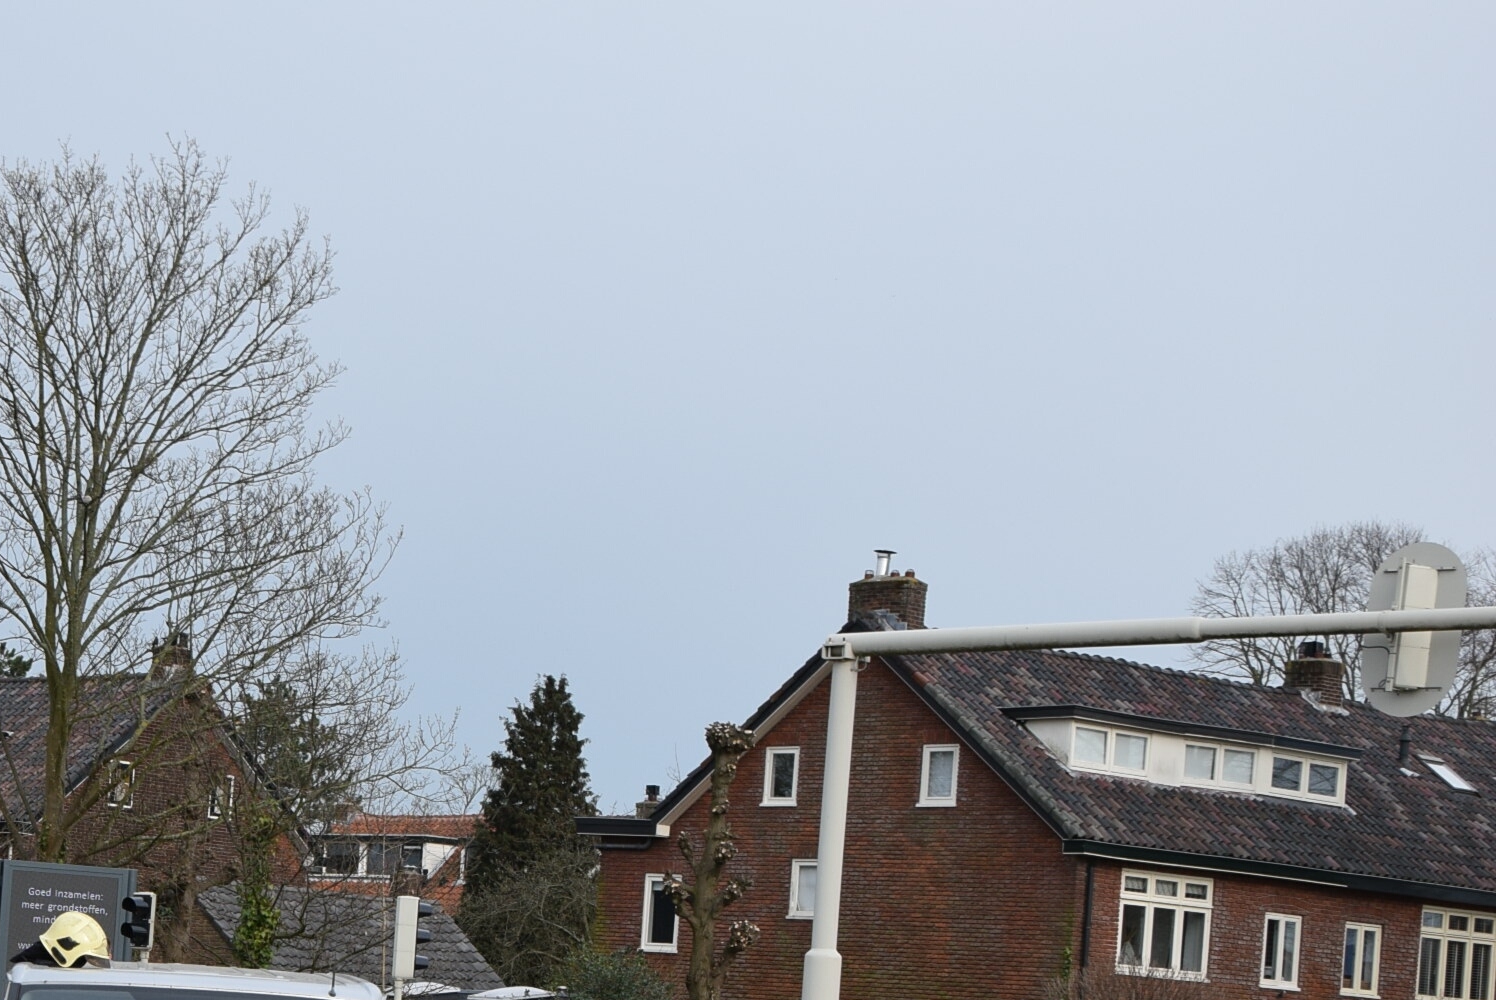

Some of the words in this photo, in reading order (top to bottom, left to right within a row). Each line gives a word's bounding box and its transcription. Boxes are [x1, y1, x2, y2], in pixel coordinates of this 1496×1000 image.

[28, 887, 52, 897] Goed
[55, 889, 104, 901] inzamelen:
[21, 901, 44, 910] meer
[47, 903, 108, 916] grondstoffen,
[33, 915, 56, 924] mind
